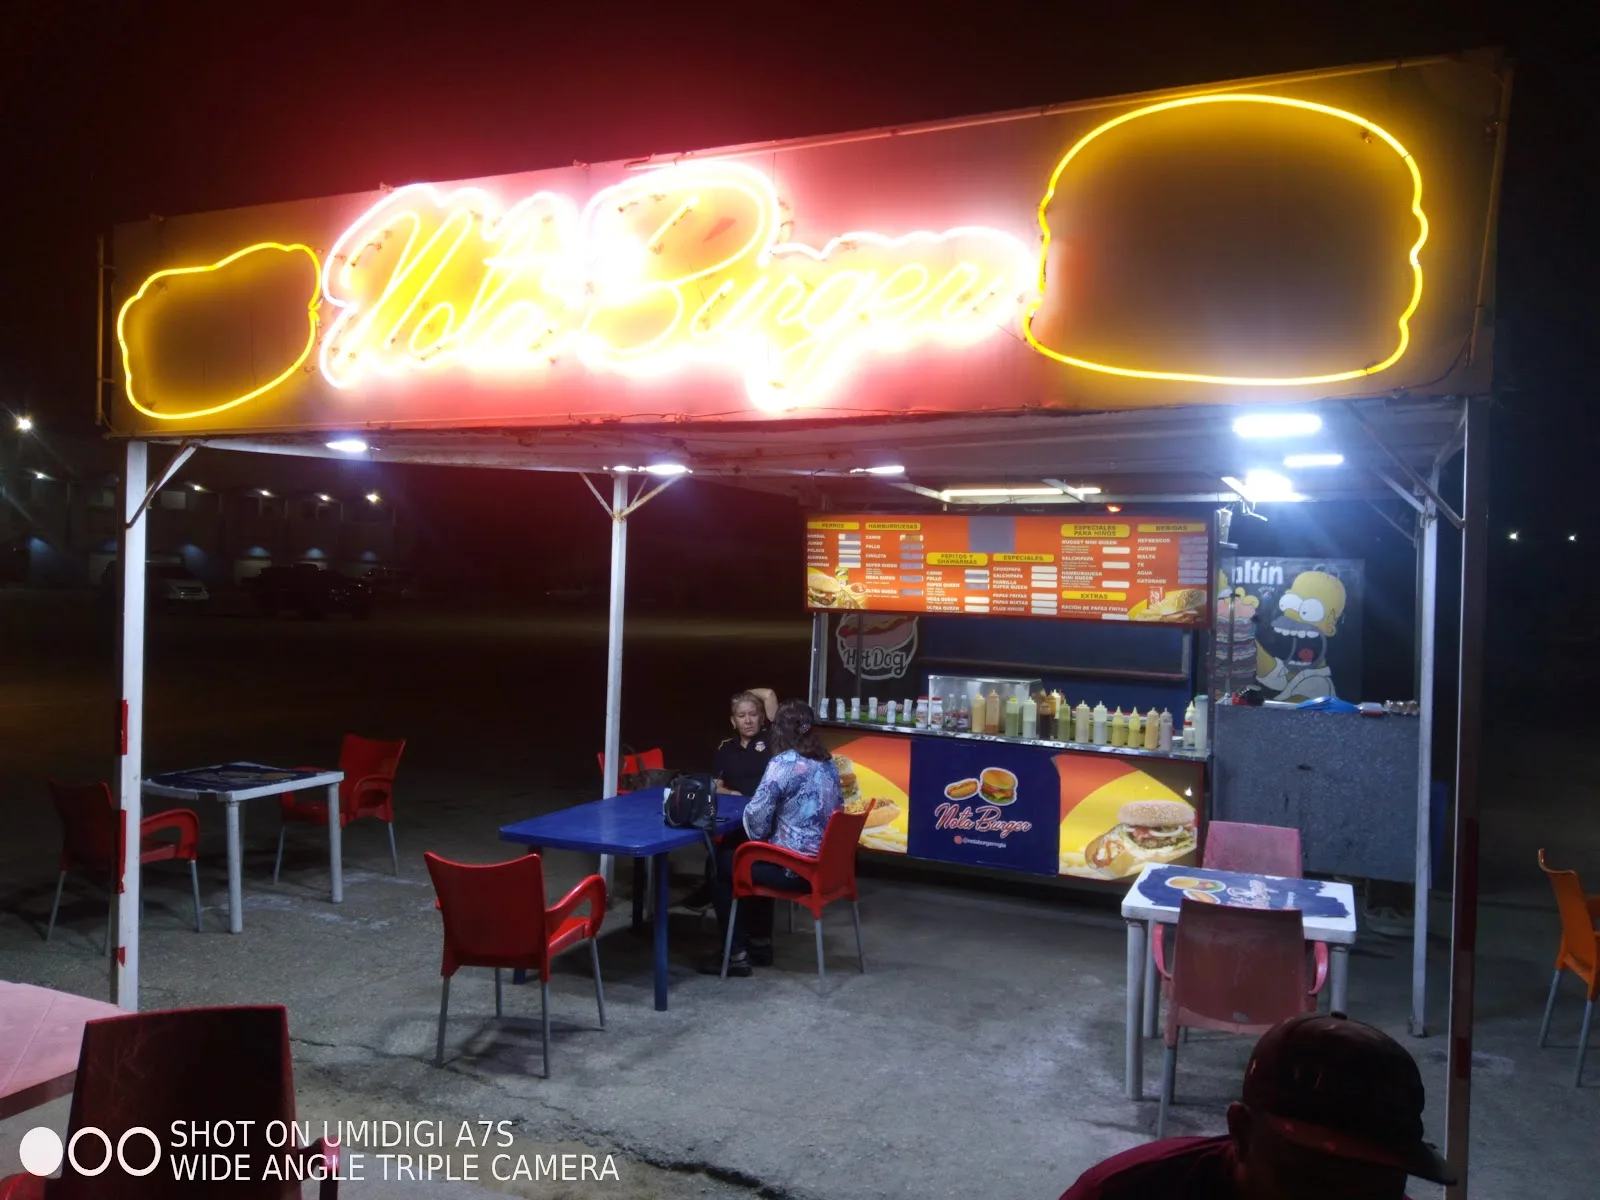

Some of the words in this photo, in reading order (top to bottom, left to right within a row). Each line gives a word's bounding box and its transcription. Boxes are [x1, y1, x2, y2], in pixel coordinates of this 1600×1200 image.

[582, 162, 1025, 406] Burger
[934, 802, 975, 830] Nota
[975, 805, 1033, 839] Burger
